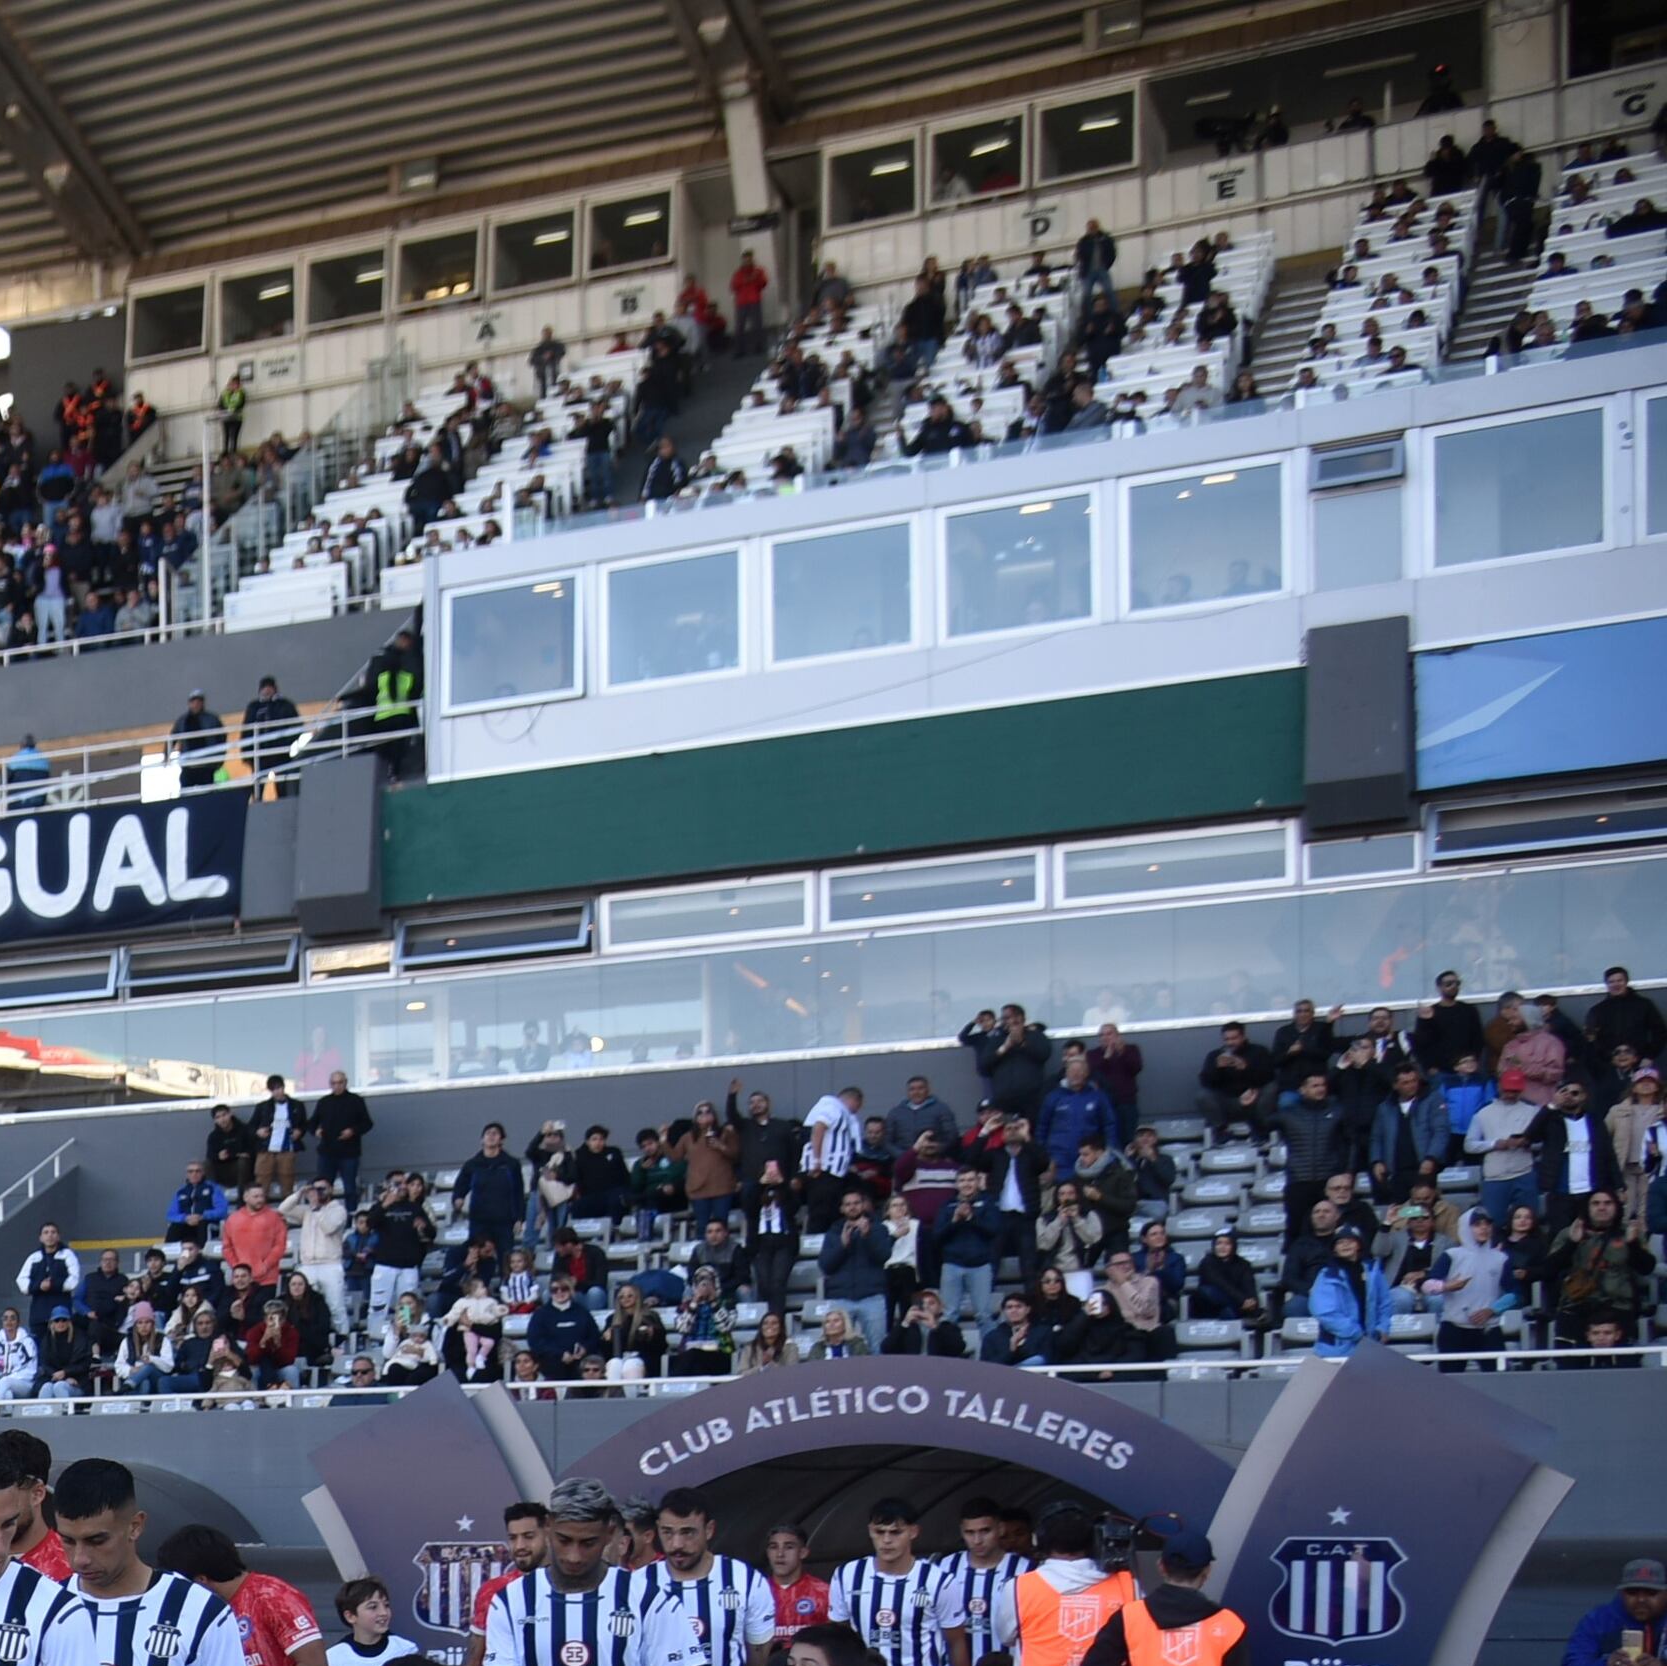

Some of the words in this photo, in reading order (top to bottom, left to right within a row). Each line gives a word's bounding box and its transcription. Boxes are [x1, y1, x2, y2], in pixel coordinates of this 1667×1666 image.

[1217, 179, 1237, 201] E
[1030, 216, 1051, 237] D
[476, 321, 497, 342] A
[639, 1417, 733, 1476] CLUB
[745, 1385, 930, 1433] ATLÉTICO
[943, 1389, 1134, 1471] TALLERES
